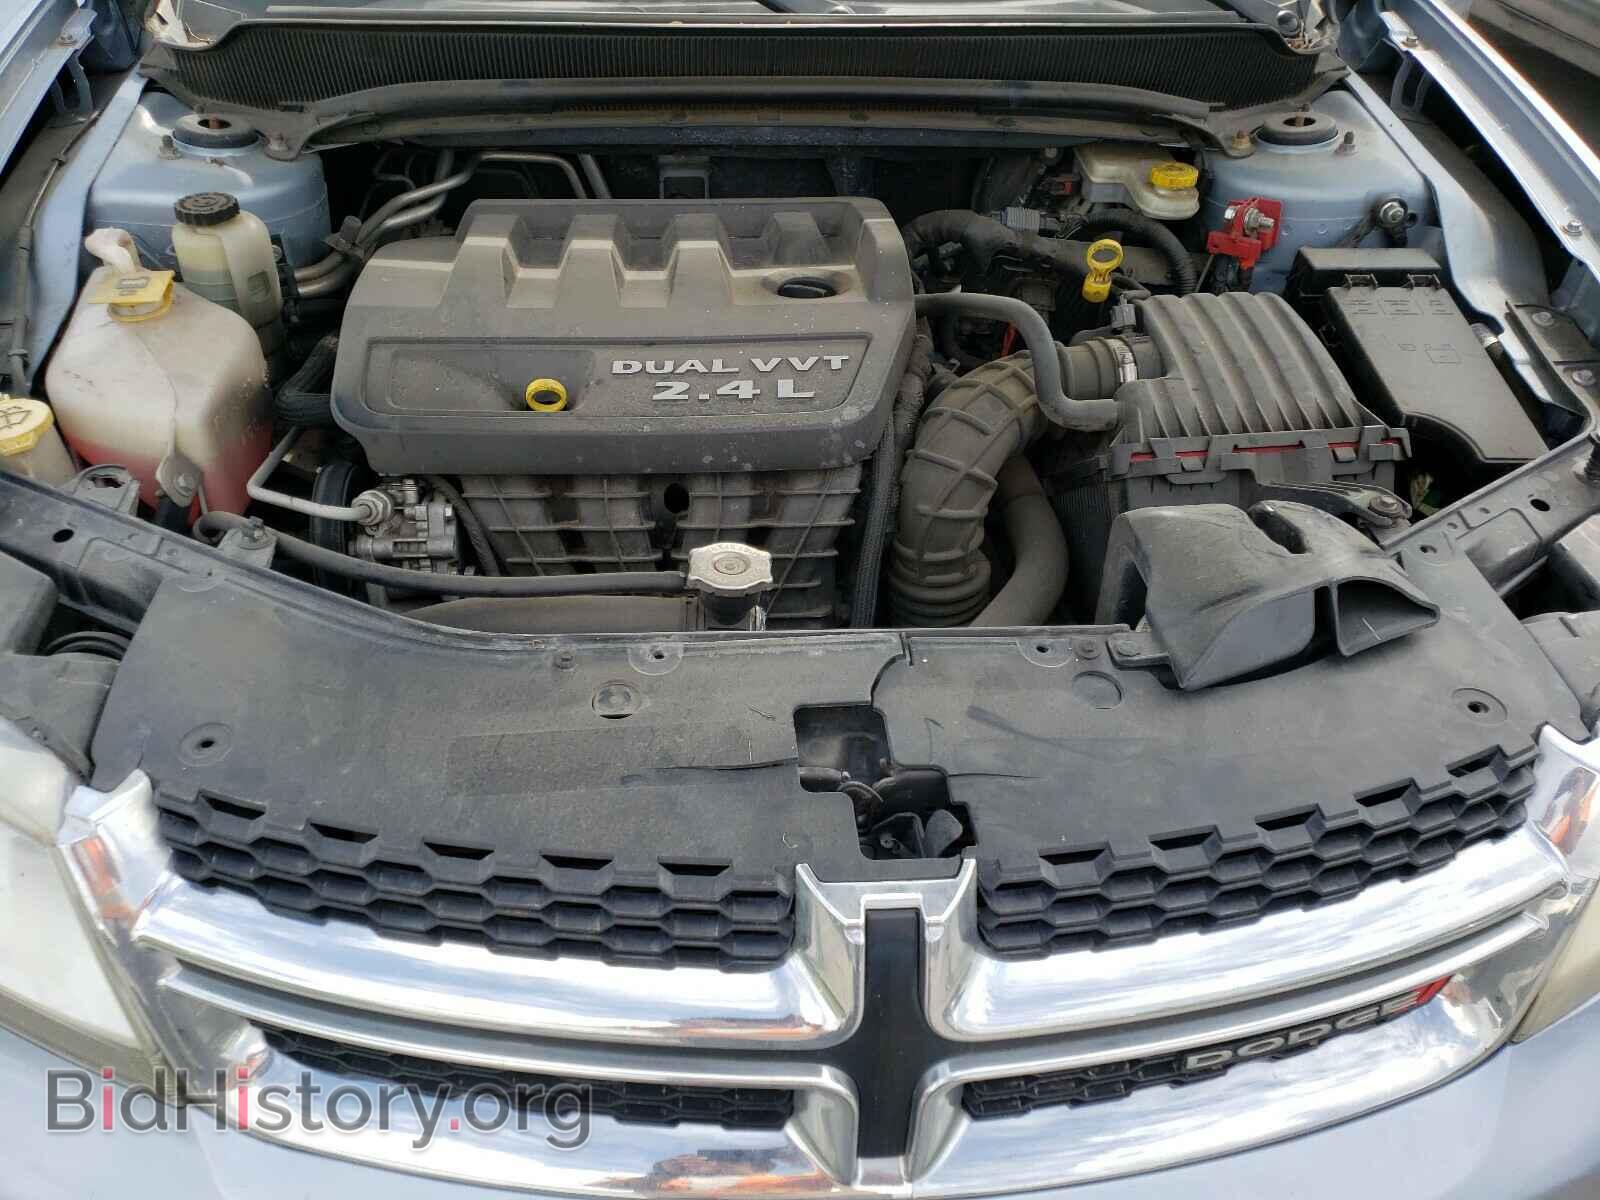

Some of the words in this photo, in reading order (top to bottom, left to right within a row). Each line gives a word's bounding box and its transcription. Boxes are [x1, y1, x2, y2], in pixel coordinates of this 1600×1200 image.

[612, 359, 739, 374] DUAL
[750, 355, 849, 372] VVT
[1185, 991, 1422, 1071] DODGE
